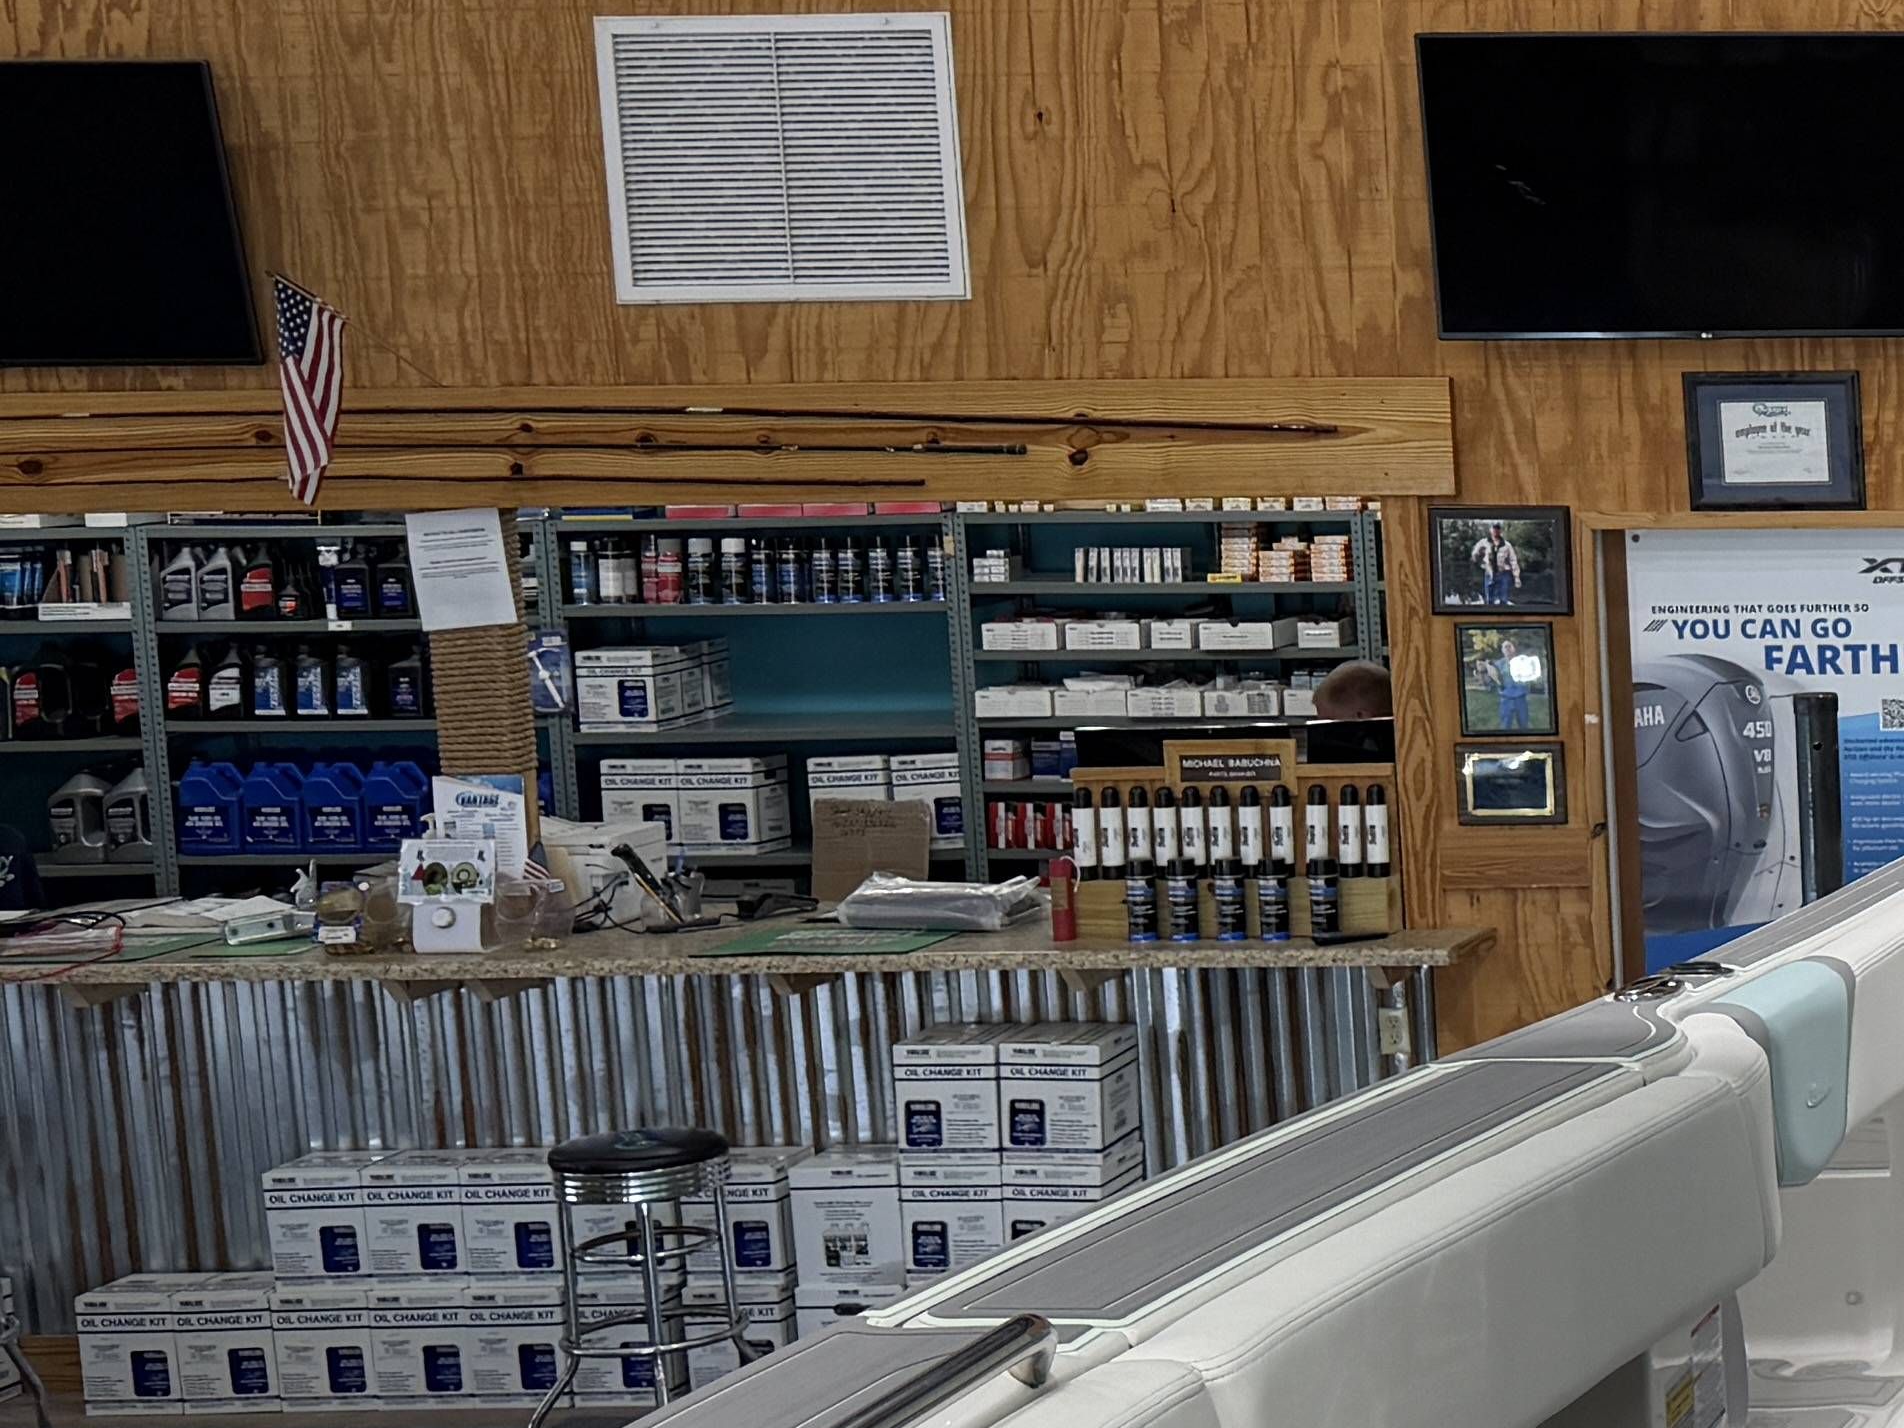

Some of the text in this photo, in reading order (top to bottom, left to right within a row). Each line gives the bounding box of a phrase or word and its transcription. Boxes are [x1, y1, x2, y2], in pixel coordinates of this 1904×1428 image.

[1651, 603, 1869, 614] ENGINEERING THAT GOES FURTHER SO
[1671, 618, 1852, 640] YOU CAN GO
[1743, 721, 1772, 738] 450
[1754, 749, 1771, 762] V8
[1183, 758, 1224, 768] MICHAEL
[604, 778, 618, 786] OIL
[620, 778, 656, 786] CHANGE
[680, 777, 748, 786] OIL CHANGE KIT
[811, 773, 878, 783] OIL CHANGE KIT
[904, 1068, 981, 1076] OIL CHANGE KIT
[1010, 1068, 1087, 1076] OIL CHANGE KIT
[268, 1192, 355, 1204] OIL CHANGE KIT
[366, 1190, 453, 1201] OIL CHANGE KIT
[465, 1188, 552, 1199] OIL CHANGE KIT
[752, 1188, 769, 1197] KIT
[911, 1189, 988, 1198] OIL CHANGE KIT
[1012, 1188, 1087, 1197] OIL CHANGE KIT
[373, 1311, 459, 1323] OIL CHANGE KIT
[470, 1310, 554, 1321] OIL CHANGE KIT
[757, 1308, 775, 1317] KIT
[81, 1317, 167, 1328] OIL CHANGE KIT
[177, 1315, 262, 1326] OIL CHANGE KIT
[276, 1313, 363, 1324] OIL CHANGE KIT
